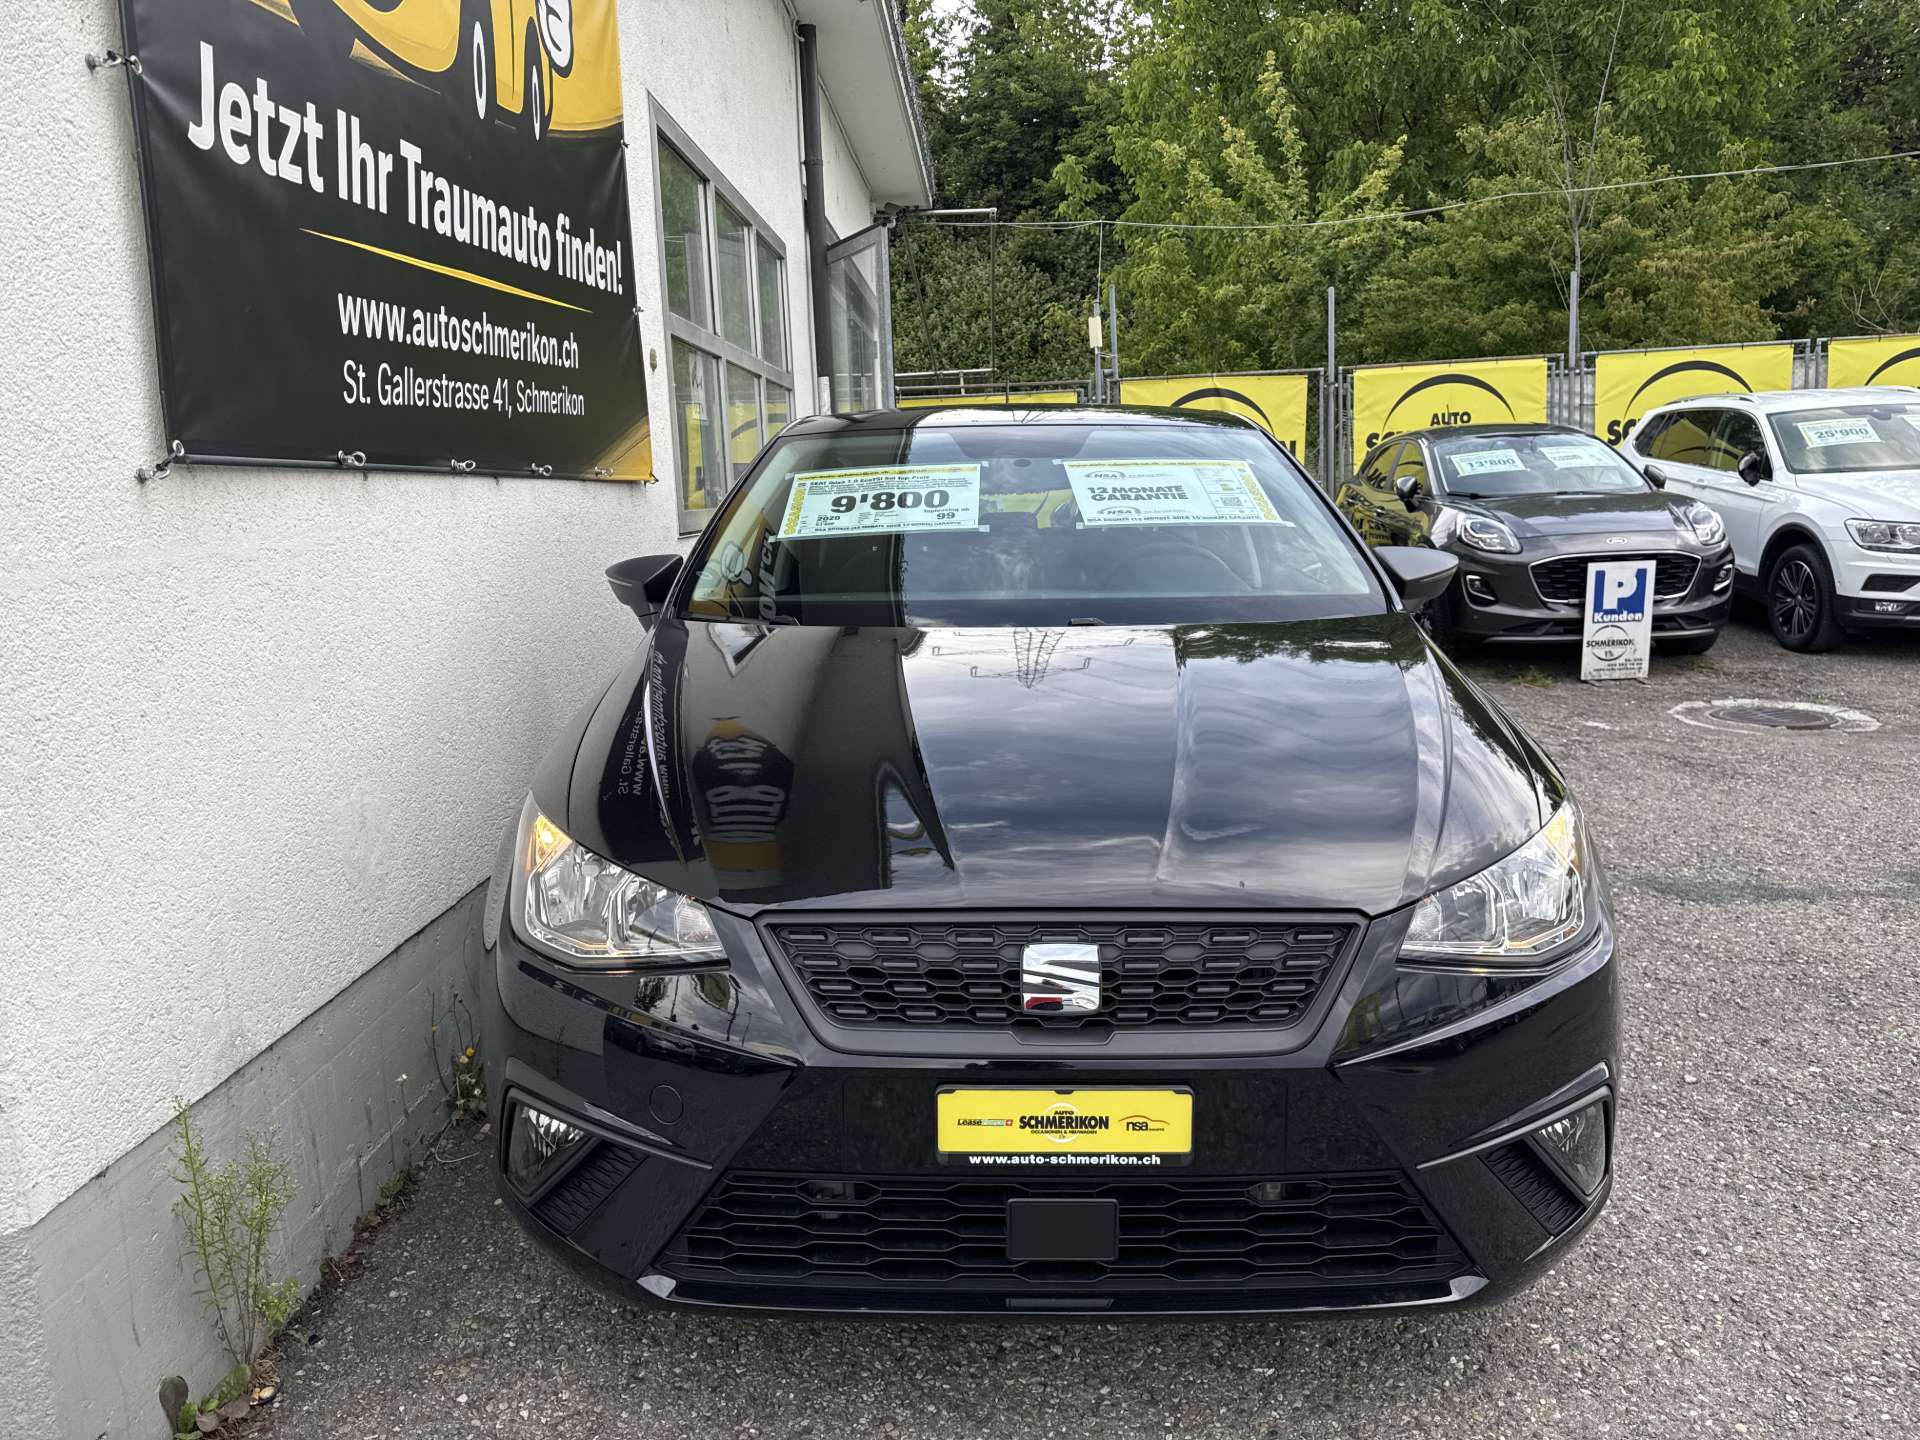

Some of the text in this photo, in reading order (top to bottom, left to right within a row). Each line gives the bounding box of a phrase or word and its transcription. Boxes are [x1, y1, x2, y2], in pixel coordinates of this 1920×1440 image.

[188, 41, 623, 295] Jetzt Ihr Traumauto finden!
[338, 293, 578, 370] www.autoschmerikon.ch
[343, 360, 585, 419] St. Gallerstrasse 41, Schmerikon
[1430, 411, 1472, 427] AUTO
[1814, 427, 1869, 439] 25'900
[1088, 485, 1184, 494] 12 MONATE
[1091, 492, 1189, 501] GARANTIE
[830, 489, 950, 514] 9'800
[1603, 568, 1637, 610] P
[1593, 610, 1643, 623] Kunden
[1019, 1115, 1110, 1130] SCHMERIKON
[1126, 1121, 1149, 1132] nsa
[968, 1153, 1161, 1166] www.auto-schmerikon.ch
